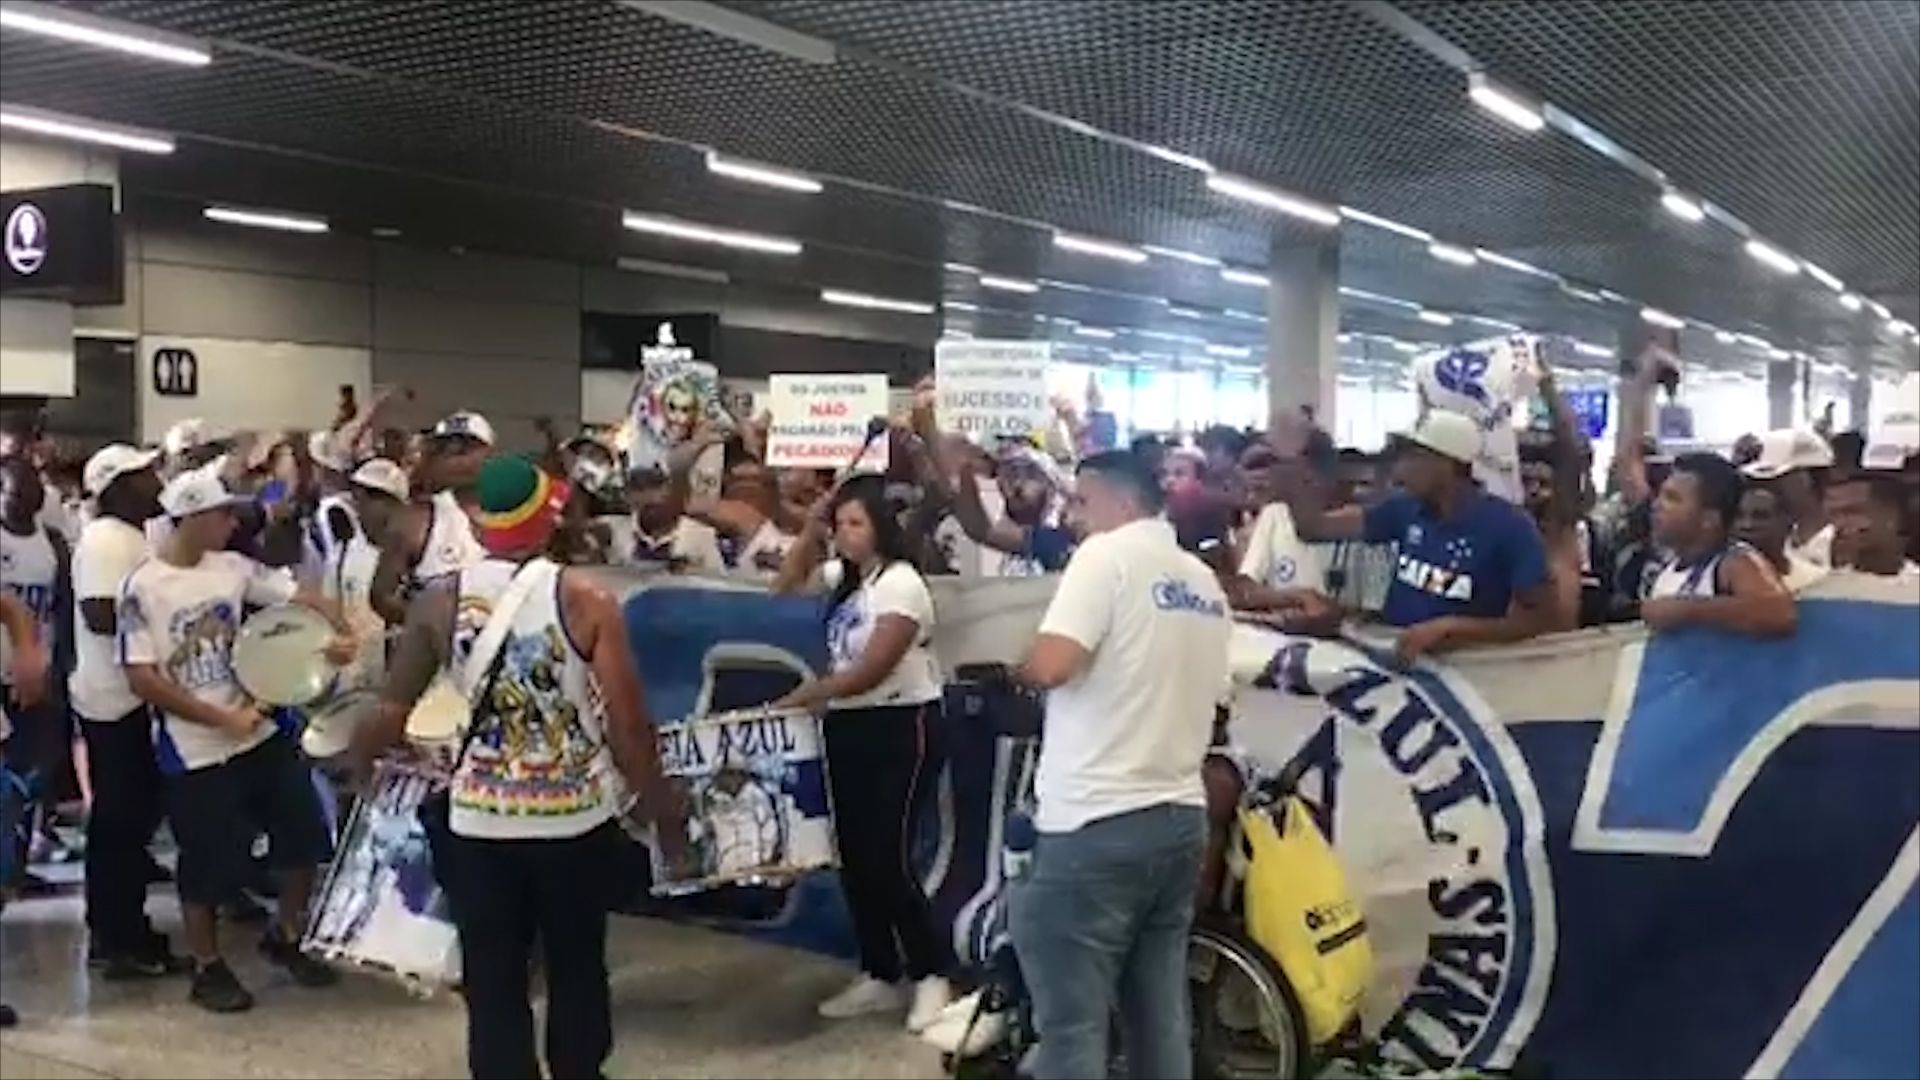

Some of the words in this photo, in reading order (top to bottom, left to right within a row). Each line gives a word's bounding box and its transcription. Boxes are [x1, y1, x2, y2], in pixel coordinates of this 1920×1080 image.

[809, 401, 848, 417] NÃO
[1398, 554, 1472, 600] CAIXA
[716, 717, 796, 766] AZUL
